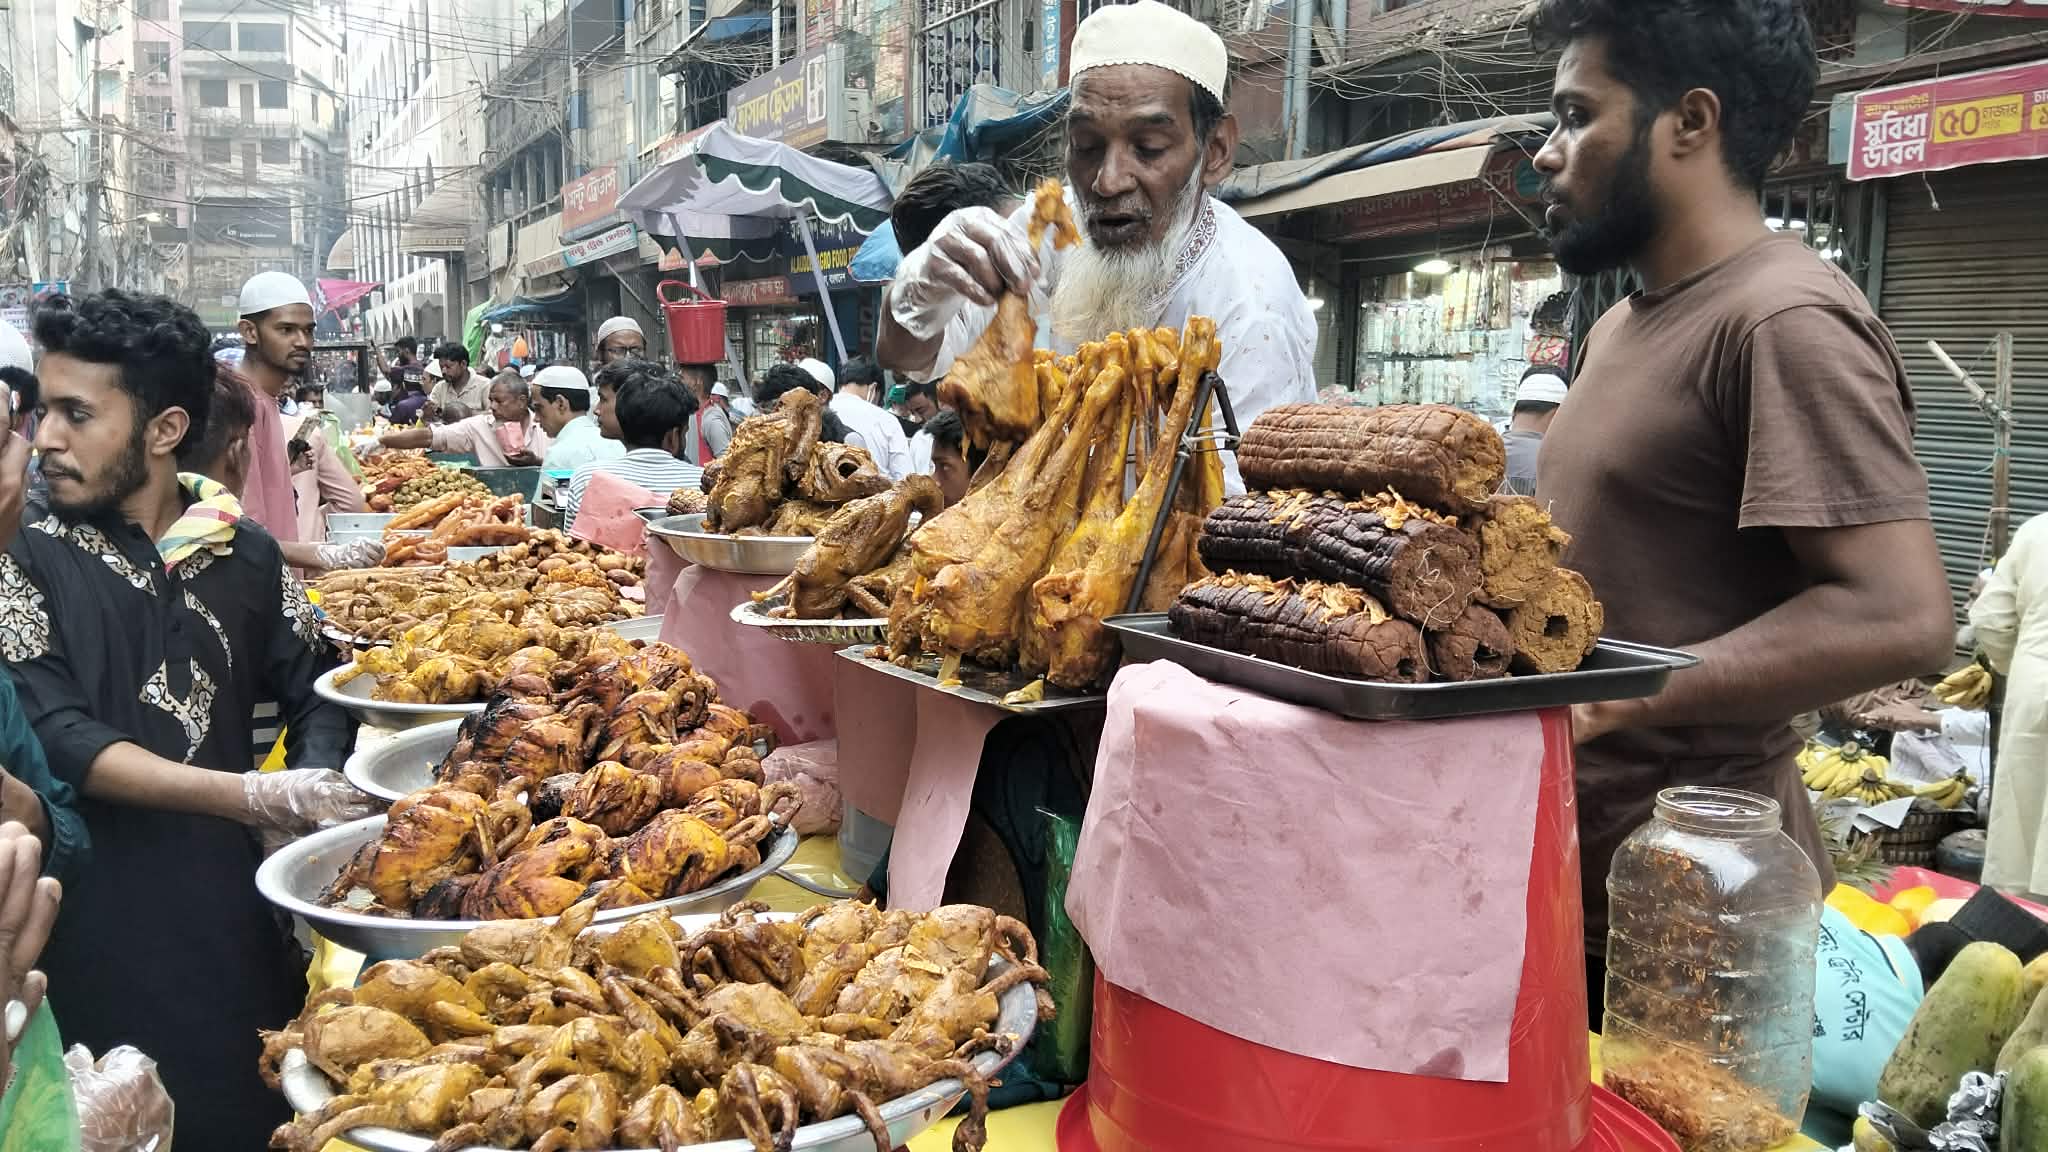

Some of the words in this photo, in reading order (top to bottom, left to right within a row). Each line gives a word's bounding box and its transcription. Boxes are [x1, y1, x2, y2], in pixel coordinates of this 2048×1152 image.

[2034, 89, 2048, 102] চা
[1864, 111, 1928, 146] সুবিধা
[1939, 107, 1980, 137] ৫০
[1982, 103, 2019, 119] হাজার
[1862, 139, 1926, 168] ডাবল
[817, 250, 831, 270] GRO
[831, 247, 848, 268] FOOD
[1841, 990, 1870, 1041] সেন্টার
